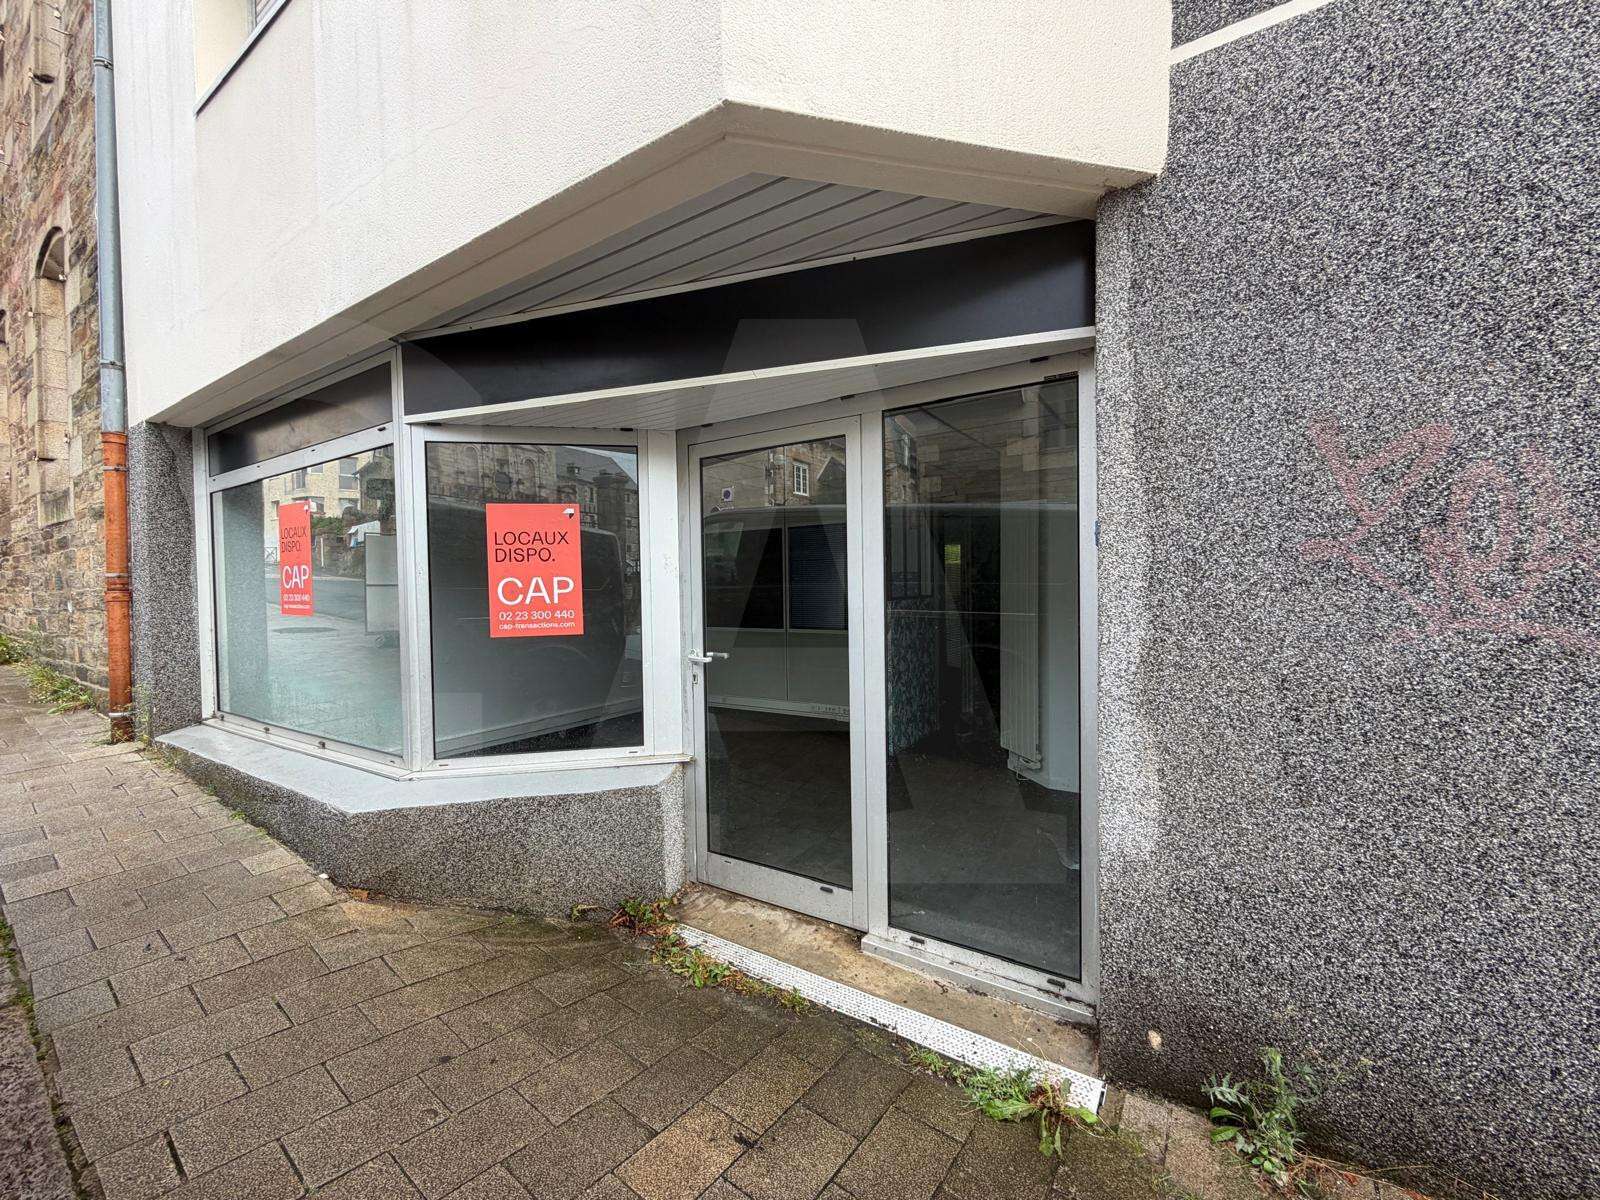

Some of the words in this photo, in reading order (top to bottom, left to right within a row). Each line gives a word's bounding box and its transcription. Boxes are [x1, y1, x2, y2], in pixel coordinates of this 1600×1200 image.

[281, 527, 307, 539] LOCAUX
[494, 531, 569, 546] LOCAUX
[495, 548, 555, 562] DISPO.
[283, 565, 309, 588] CAP
[497, 576, 575, 605] CAP
[499, 611, 512, 621] 02
[515, 611, 528, 620] 23
[531, 610, 552, 620] 300
[555, 609, 575, 619] 440
[499, 621, 576, 630] cap-transactions.com
